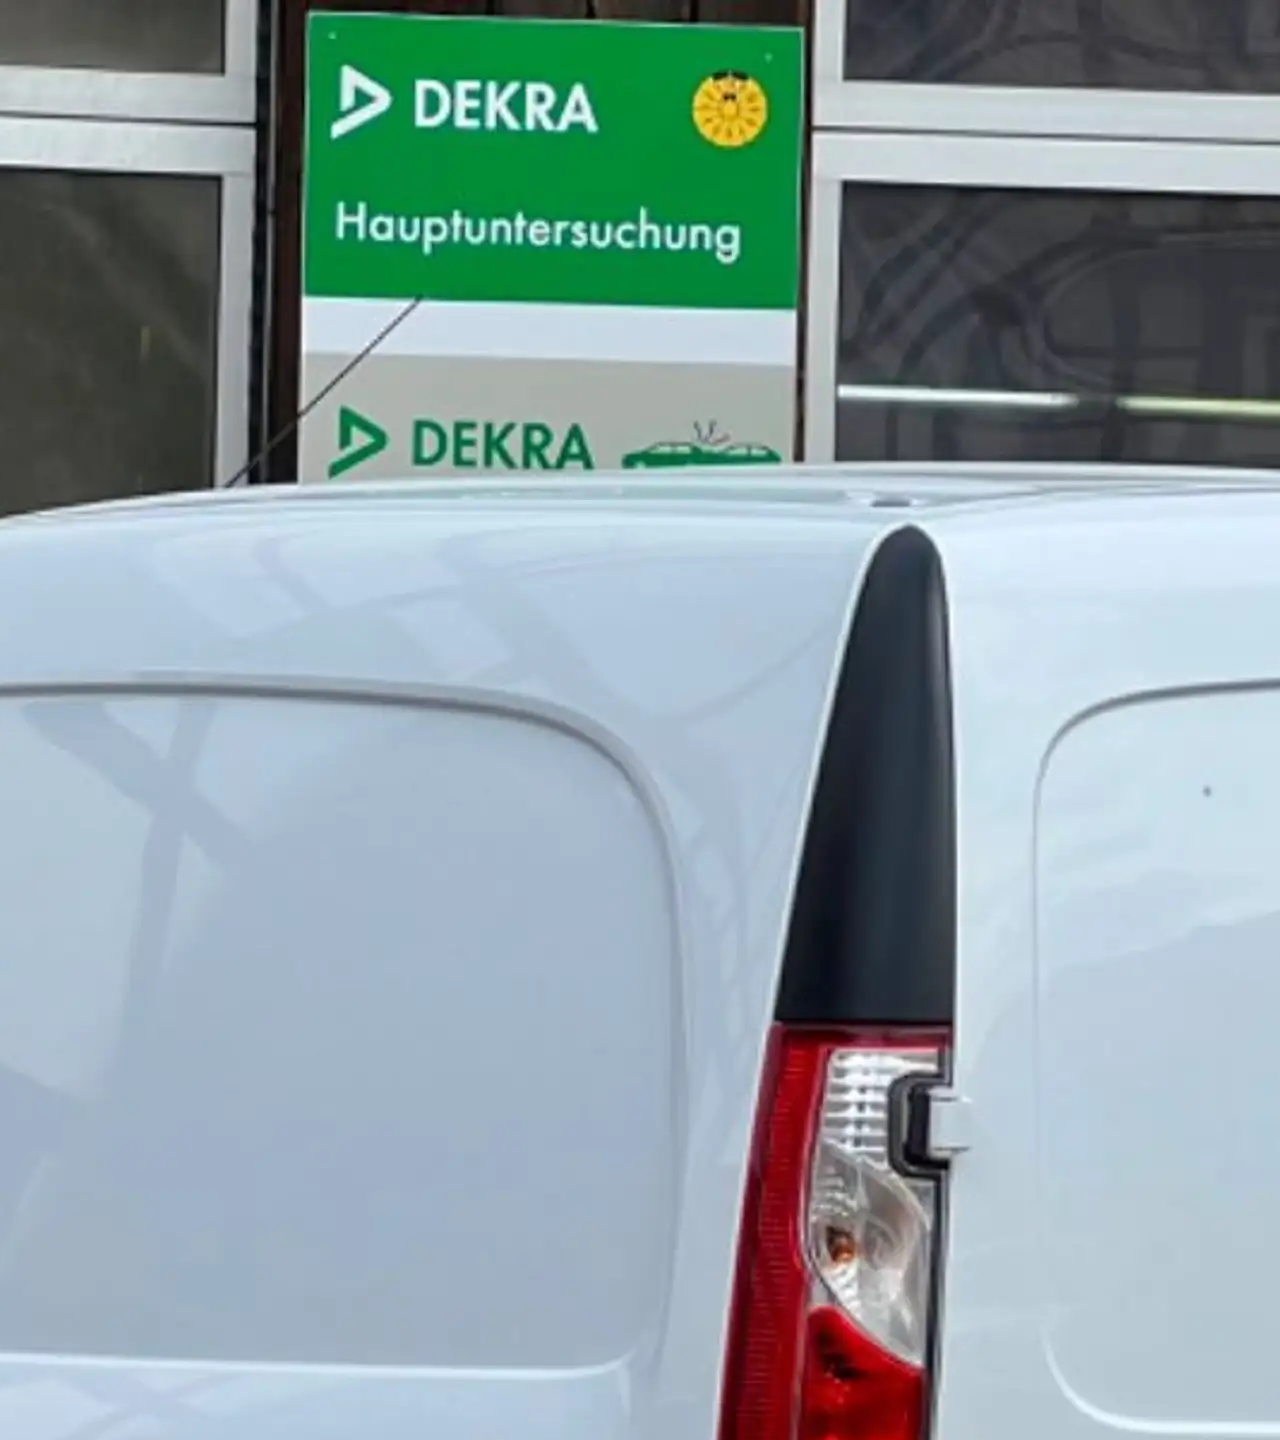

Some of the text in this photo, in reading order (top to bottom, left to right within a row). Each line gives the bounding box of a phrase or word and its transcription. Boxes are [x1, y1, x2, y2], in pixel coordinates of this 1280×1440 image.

[413, 79, 599, 133] DEKRA
[335, 202, 742, 264] Hauptuntersuchung
[412, 420, 595, 470] DEKRA
